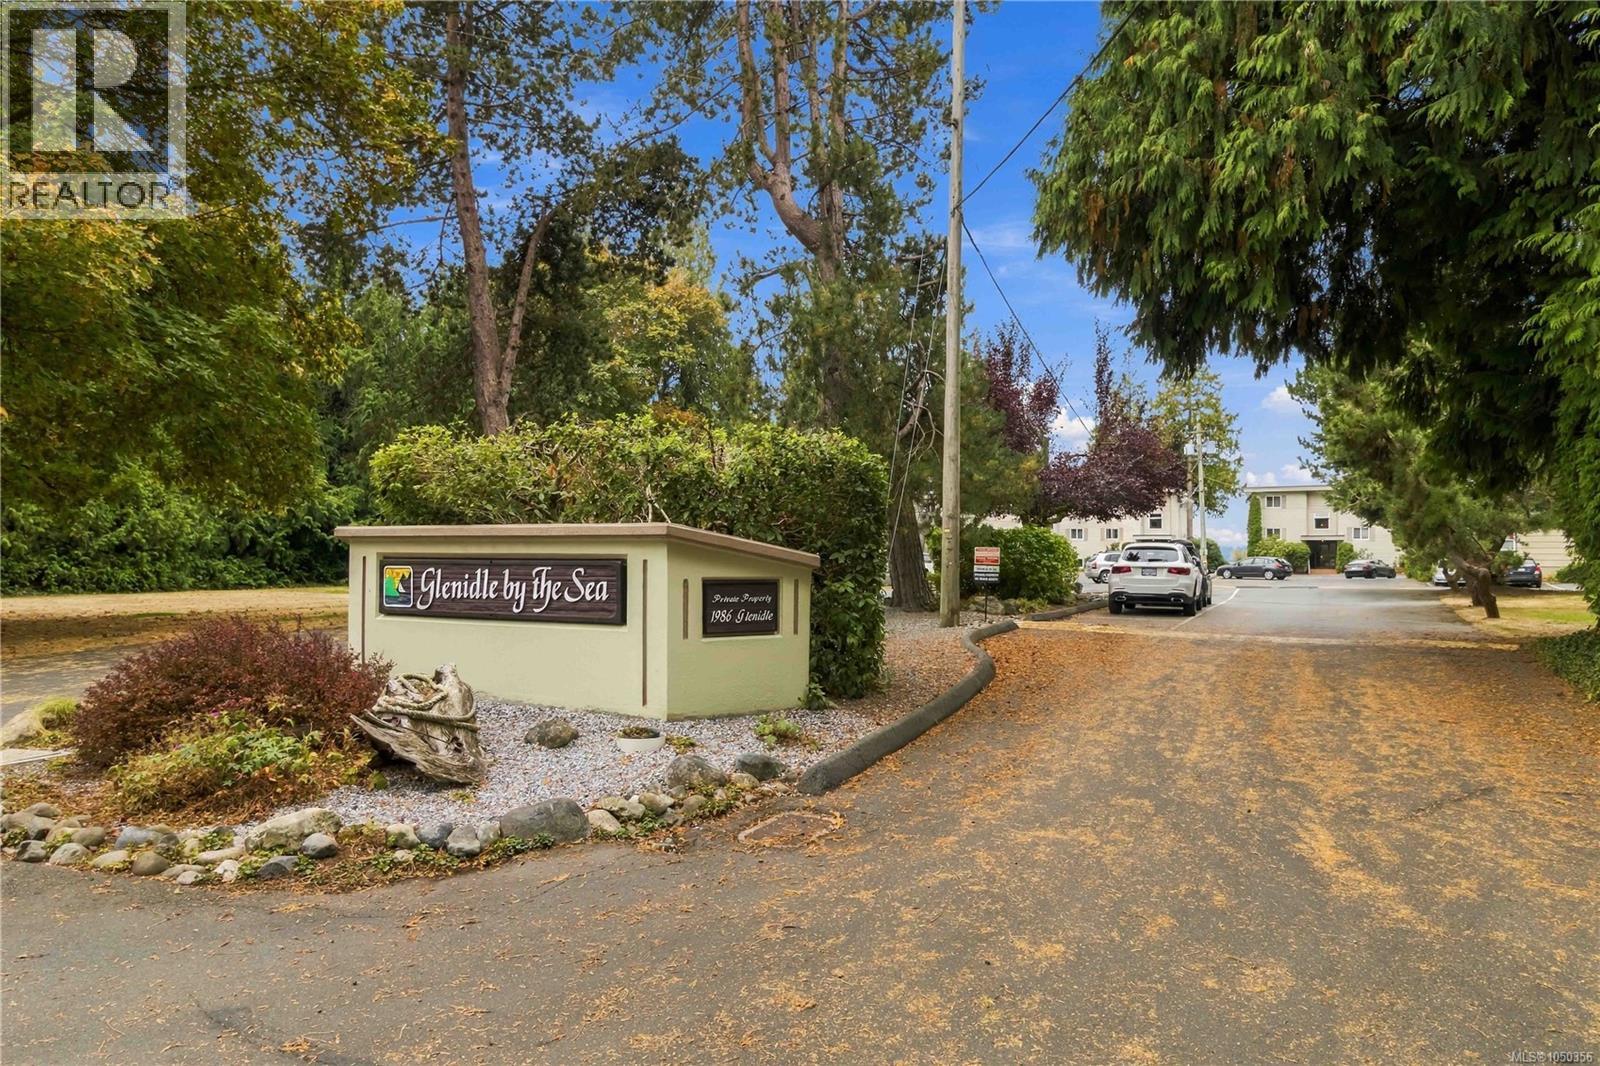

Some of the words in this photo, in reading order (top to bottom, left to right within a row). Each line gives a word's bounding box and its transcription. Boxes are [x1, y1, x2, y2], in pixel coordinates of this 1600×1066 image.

[416, 567, 499, 610] Glenidle
[503, 568, 527, 613] by
[564, 567, 610, 603] Sea
[712, 593, 740, 603] Private
[741, 593, 772, 603] Property
[711, 609, 734, 623] 1986
[735, 608, 774, 624] Glenidle
